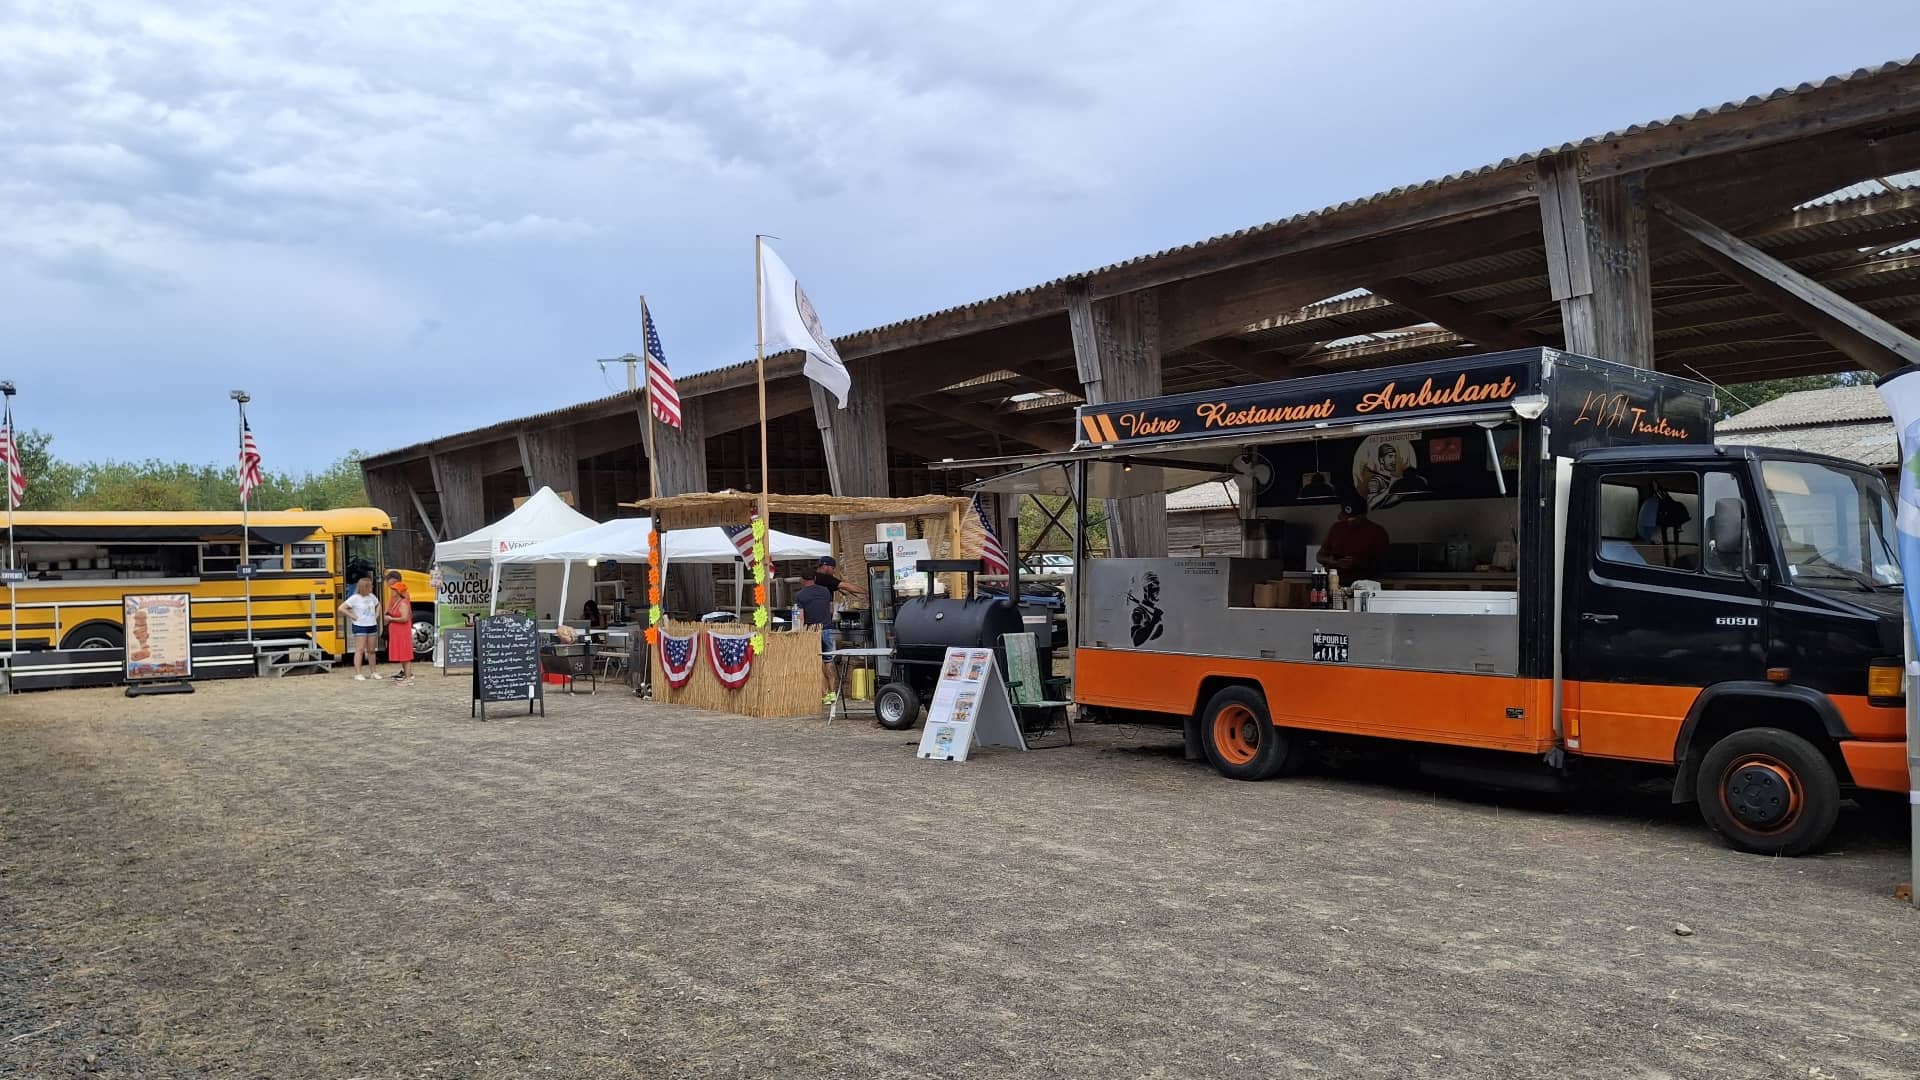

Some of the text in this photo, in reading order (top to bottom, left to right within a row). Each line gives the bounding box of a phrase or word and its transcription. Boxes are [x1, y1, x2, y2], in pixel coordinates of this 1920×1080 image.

[1119, 373, 1517, 438] Votre Restaurant Ambulant
[1631, 407, 1688, 439] Traiteur
[1322, 635, 1339, 644] POUR
[1339, 636, 1348, 645] LE
